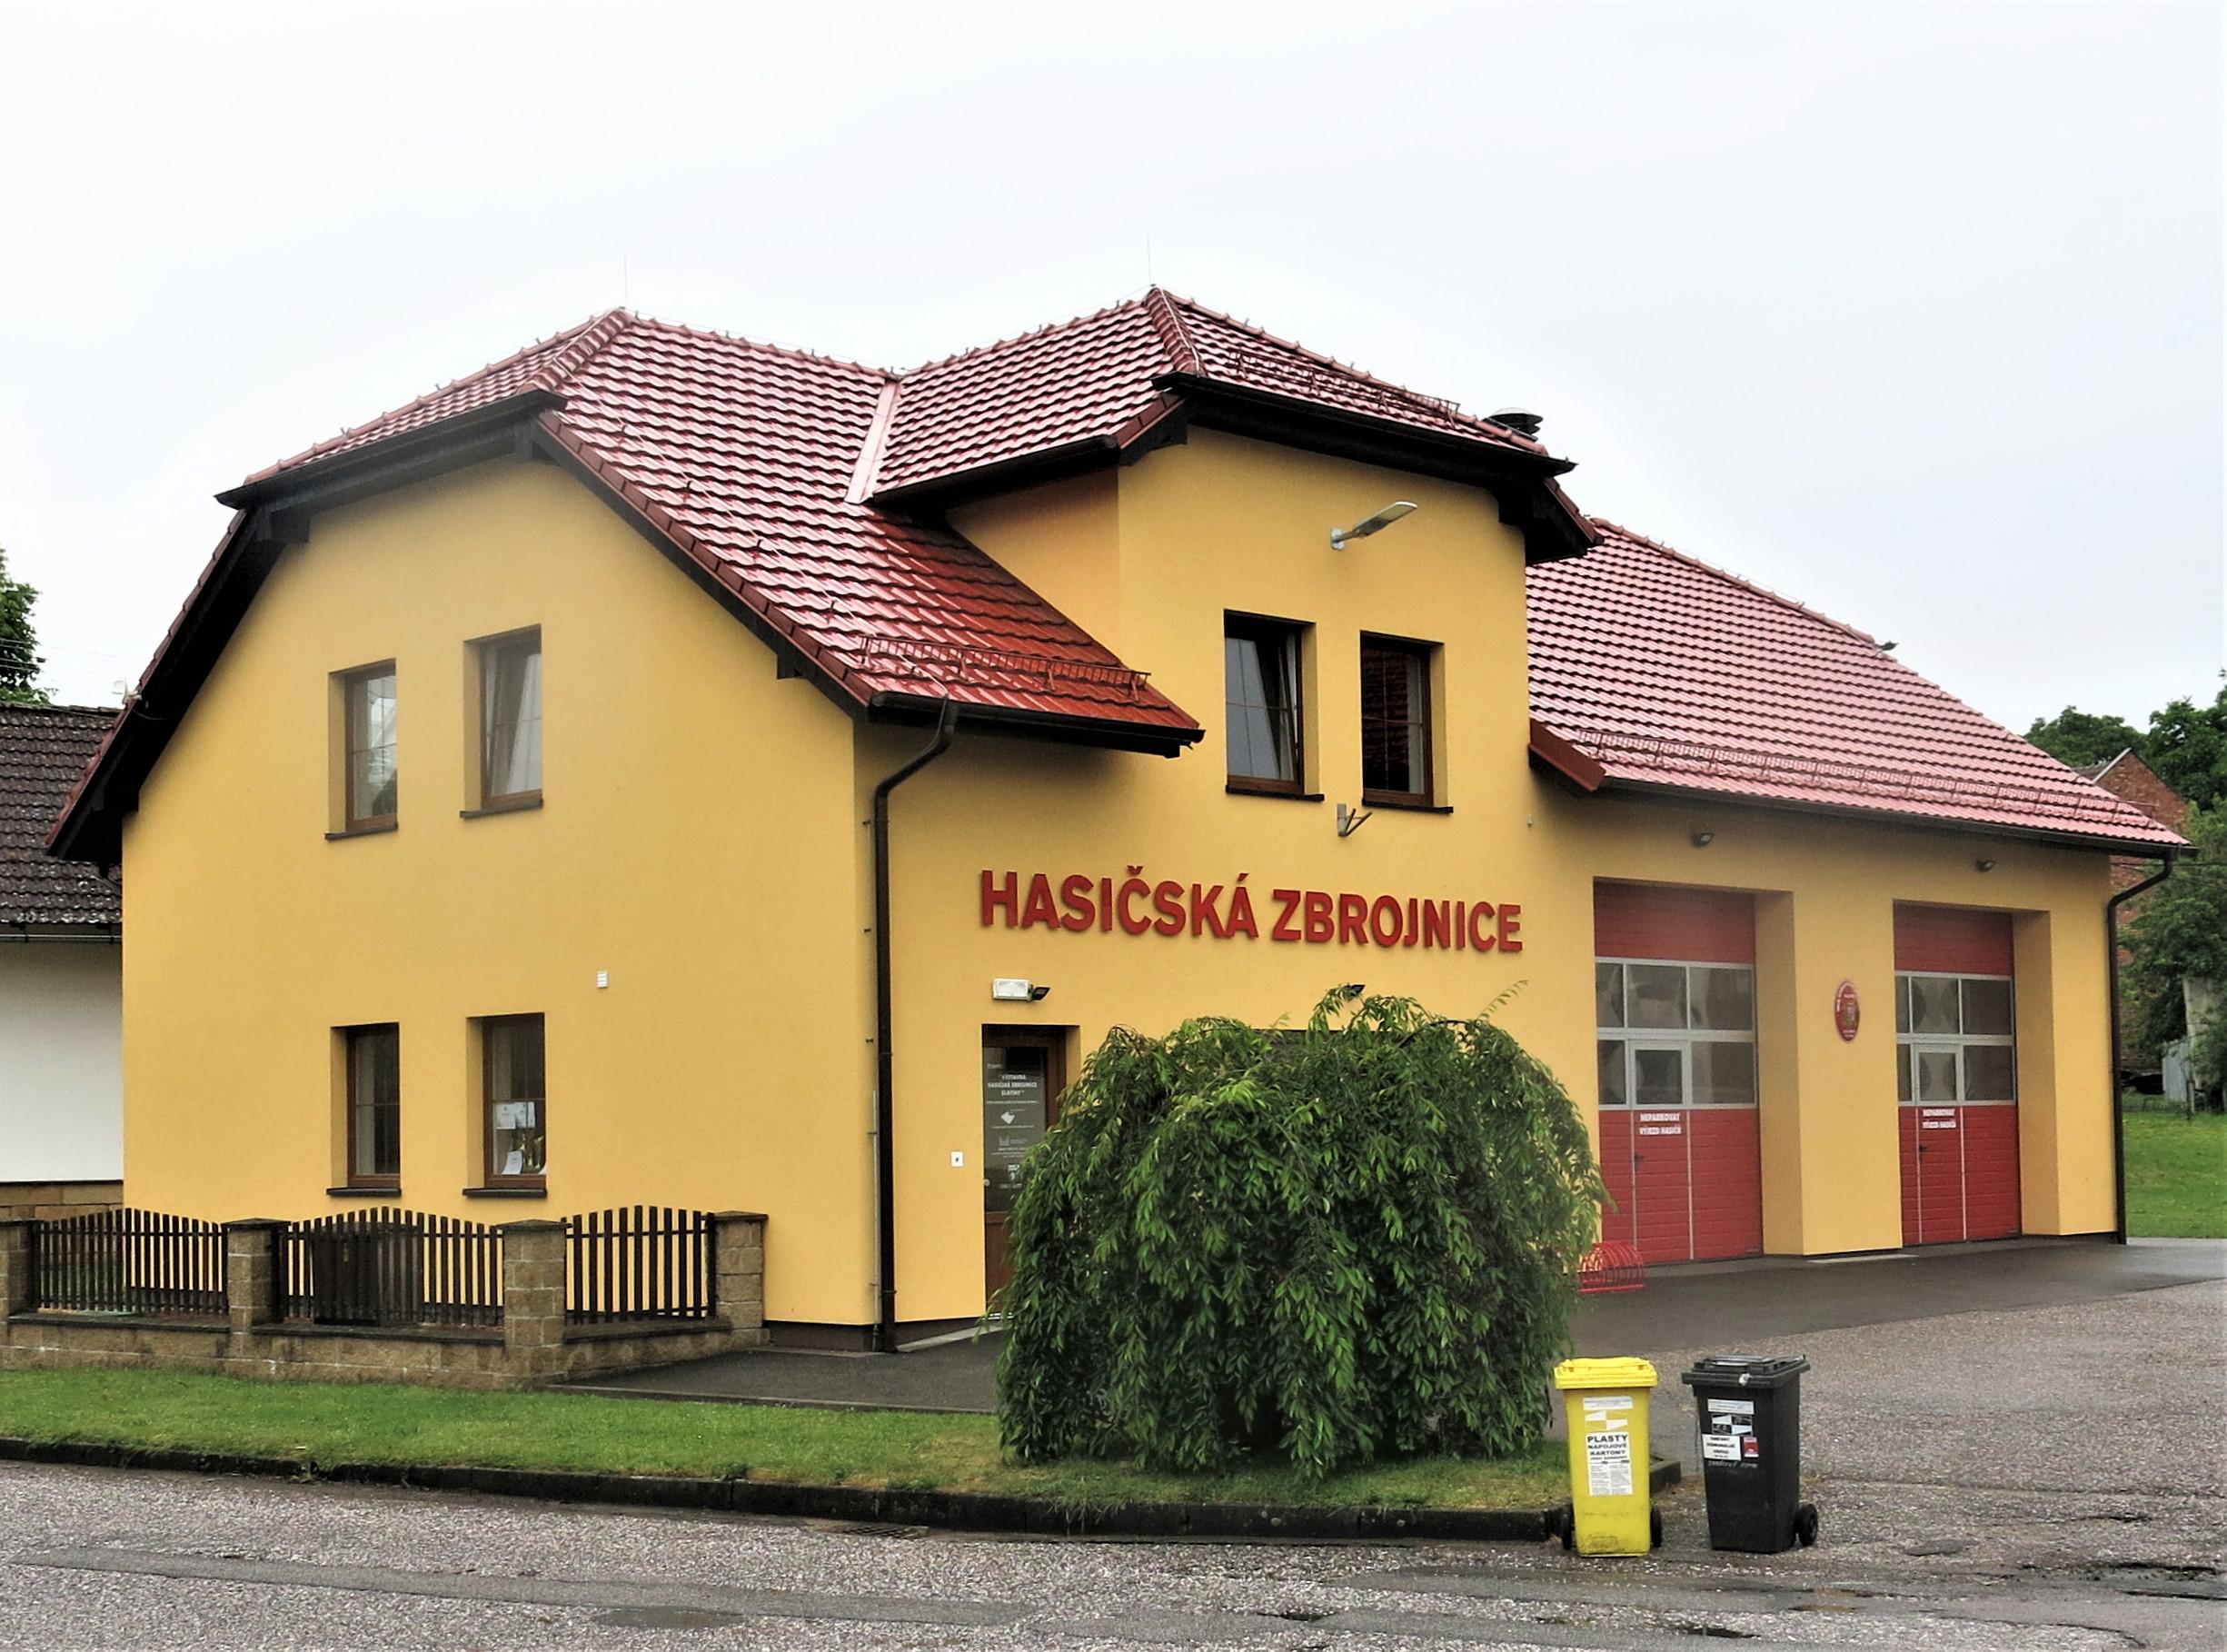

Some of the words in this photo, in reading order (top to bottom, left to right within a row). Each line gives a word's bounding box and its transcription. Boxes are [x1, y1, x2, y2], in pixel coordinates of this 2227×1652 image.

[980, 865, 1258, 940] HASIČSKÁ
[1272, 889, 1523, 952] ZBROJNICE
[1587, 1434, 1628, 1443] PLASTY
